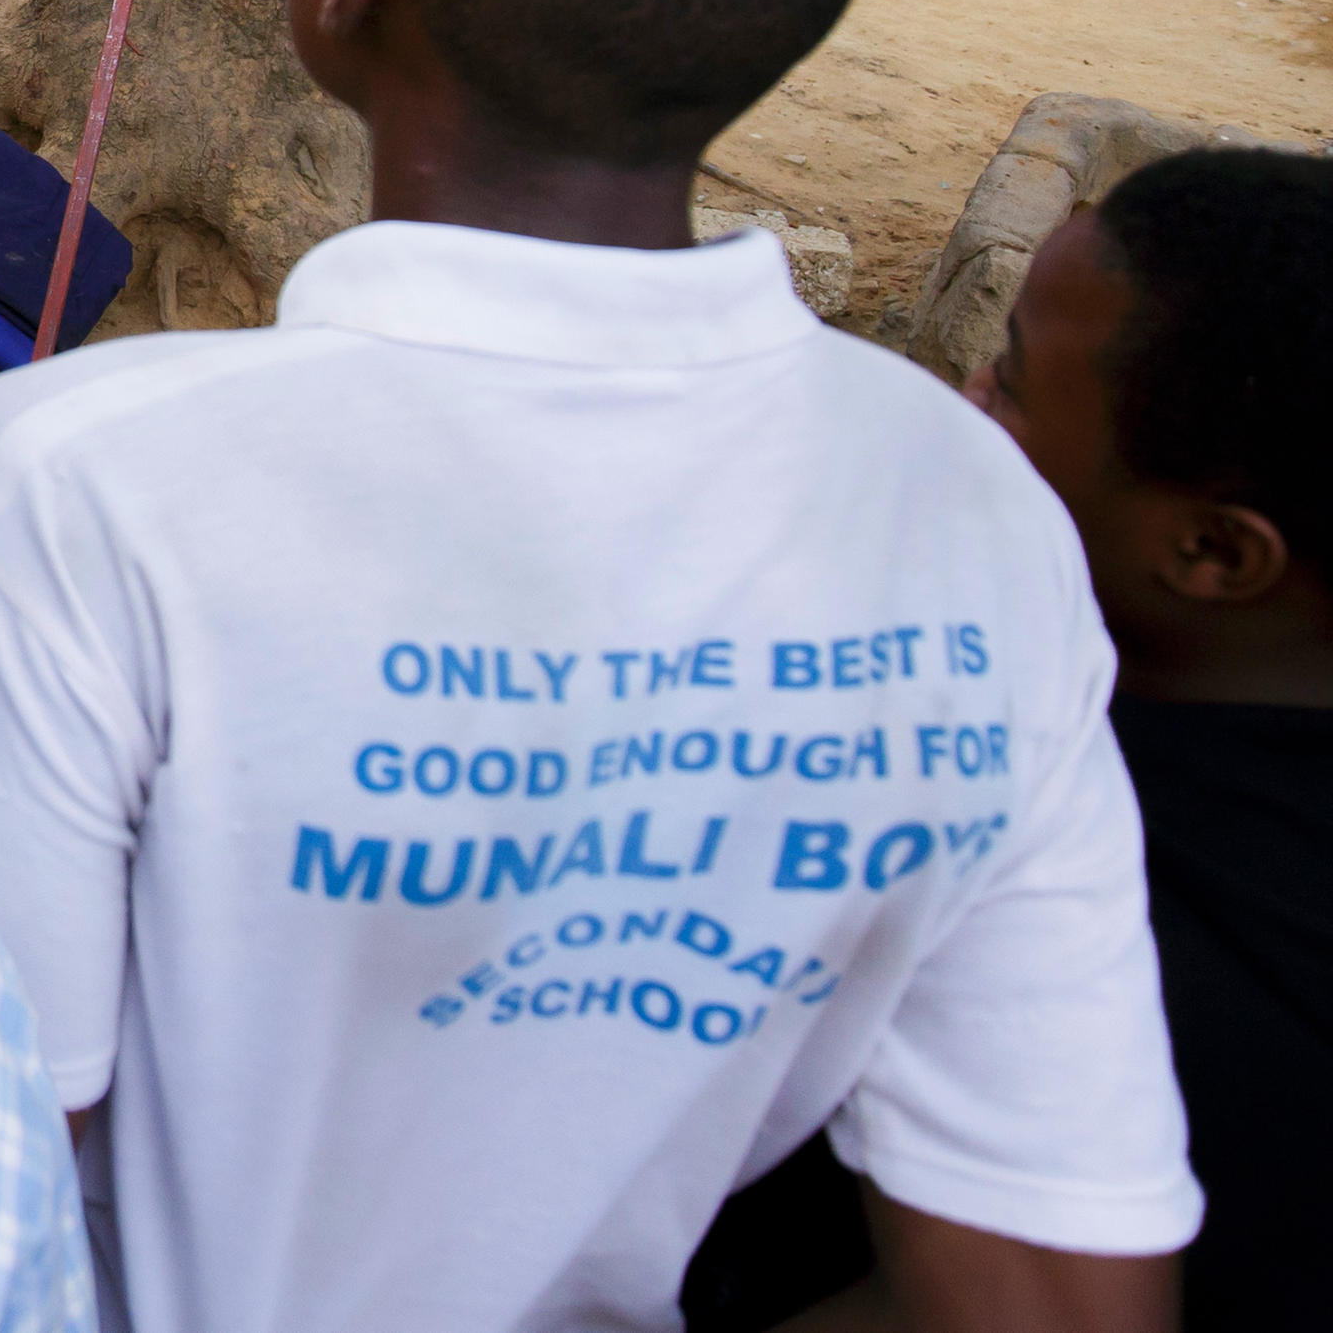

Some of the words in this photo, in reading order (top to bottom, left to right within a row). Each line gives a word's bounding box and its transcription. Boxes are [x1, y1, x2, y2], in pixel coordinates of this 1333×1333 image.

[382, 643, 579, 703] ONLY
[602, 639, 736, 699] THE
[771, 626, 924, 688] BEST
[944, 622, 990, 675] IS
[355, 742, 570, 798] GOOD
[589, 726, 889, 788] ENOUGH
[918, 724, 1010, 779] FOR
[290, 810, 728, 908] MUNALI
